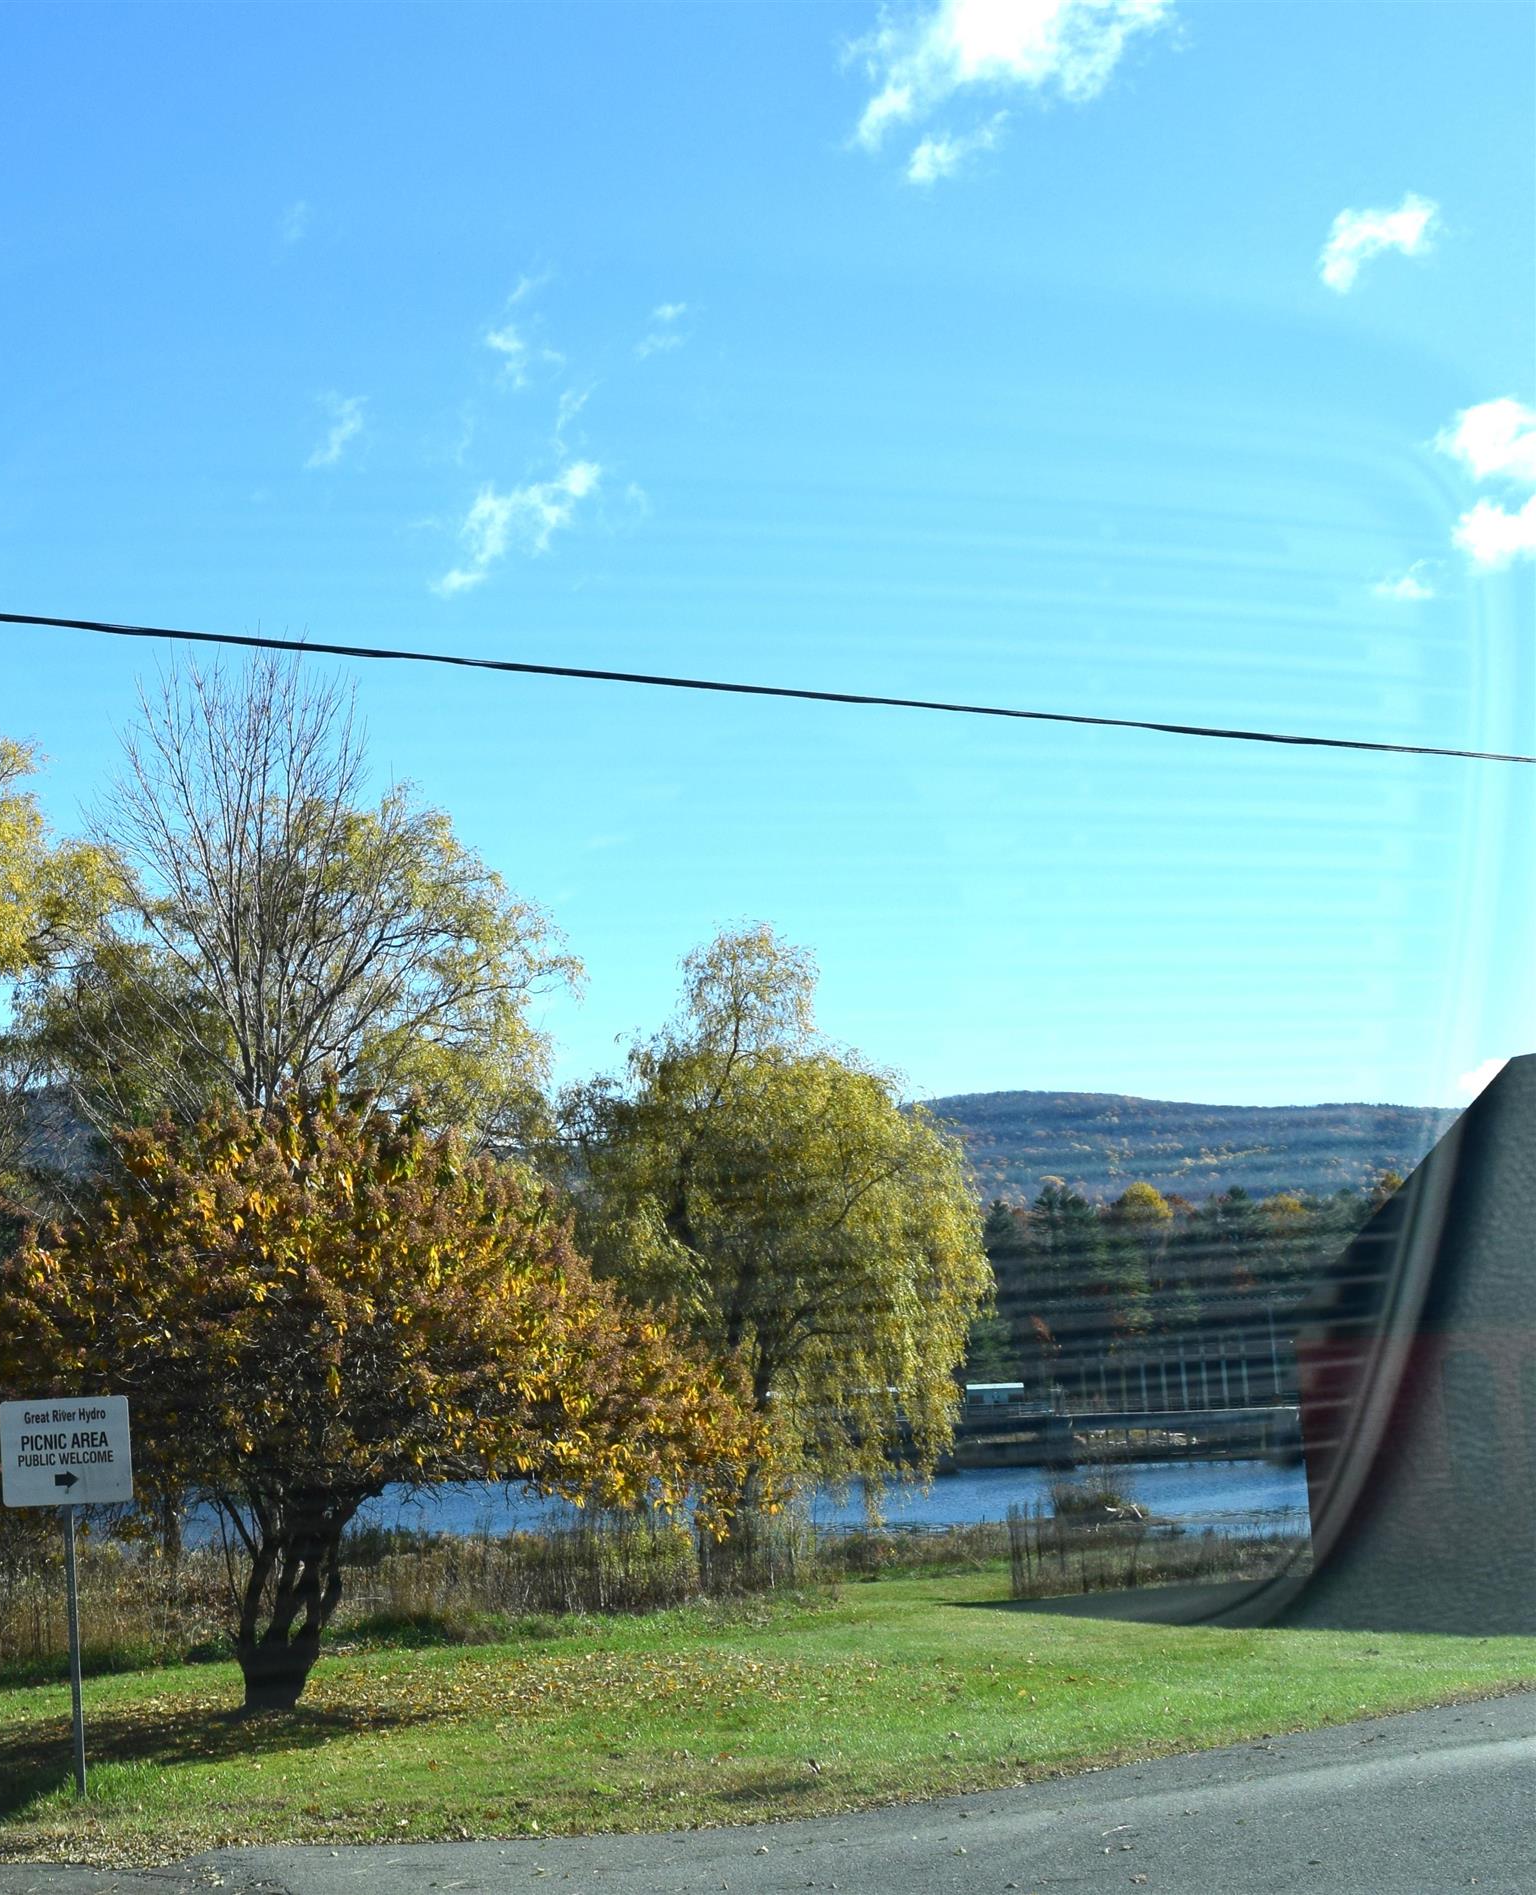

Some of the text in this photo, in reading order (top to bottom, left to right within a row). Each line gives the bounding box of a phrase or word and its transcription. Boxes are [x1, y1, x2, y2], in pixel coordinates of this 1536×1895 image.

[24, 1407, 106, 1424] Great River Hydro
[21, 1431, 109, 1451] PICNIC AREA
[18, 1450, 114, 1468] PUBLIC WELCOME
